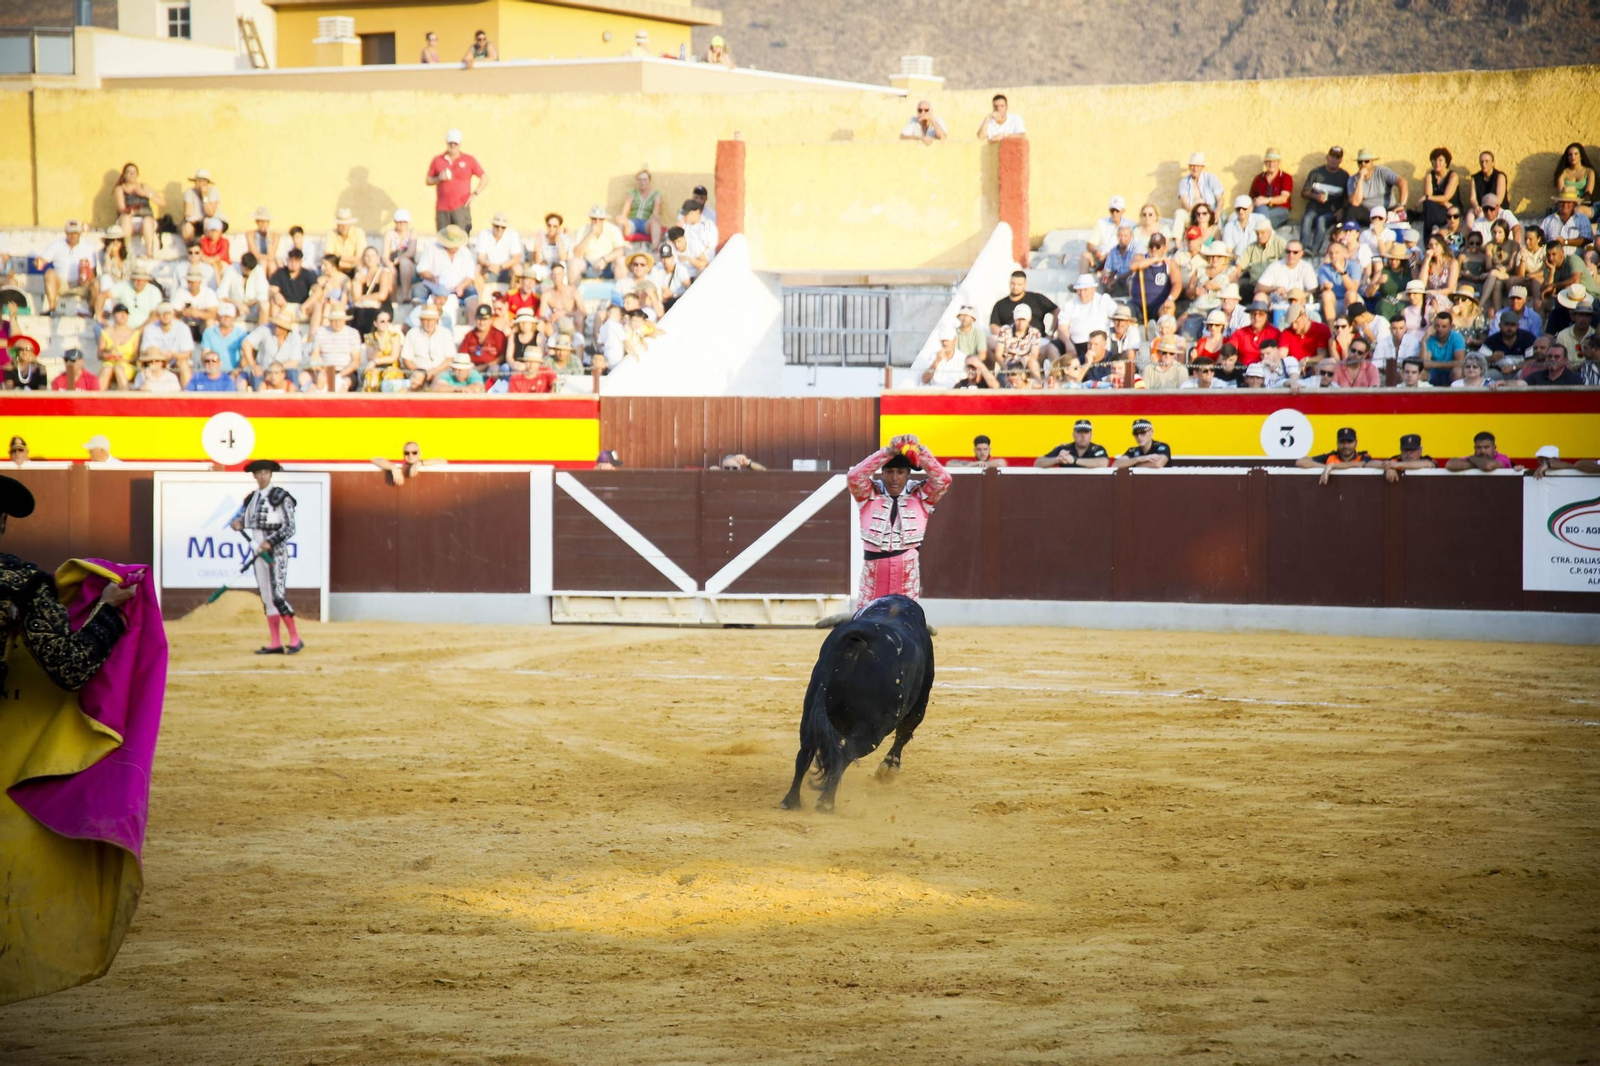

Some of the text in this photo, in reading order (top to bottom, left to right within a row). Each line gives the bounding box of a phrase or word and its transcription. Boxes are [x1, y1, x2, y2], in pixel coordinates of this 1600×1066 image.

[220, 429, 235, 448] 4
[1280, 426, 1295, 448] 3
[1565, 526, 1580, 534] BIO
[1550, 556, 1573, 564] CTRA.
